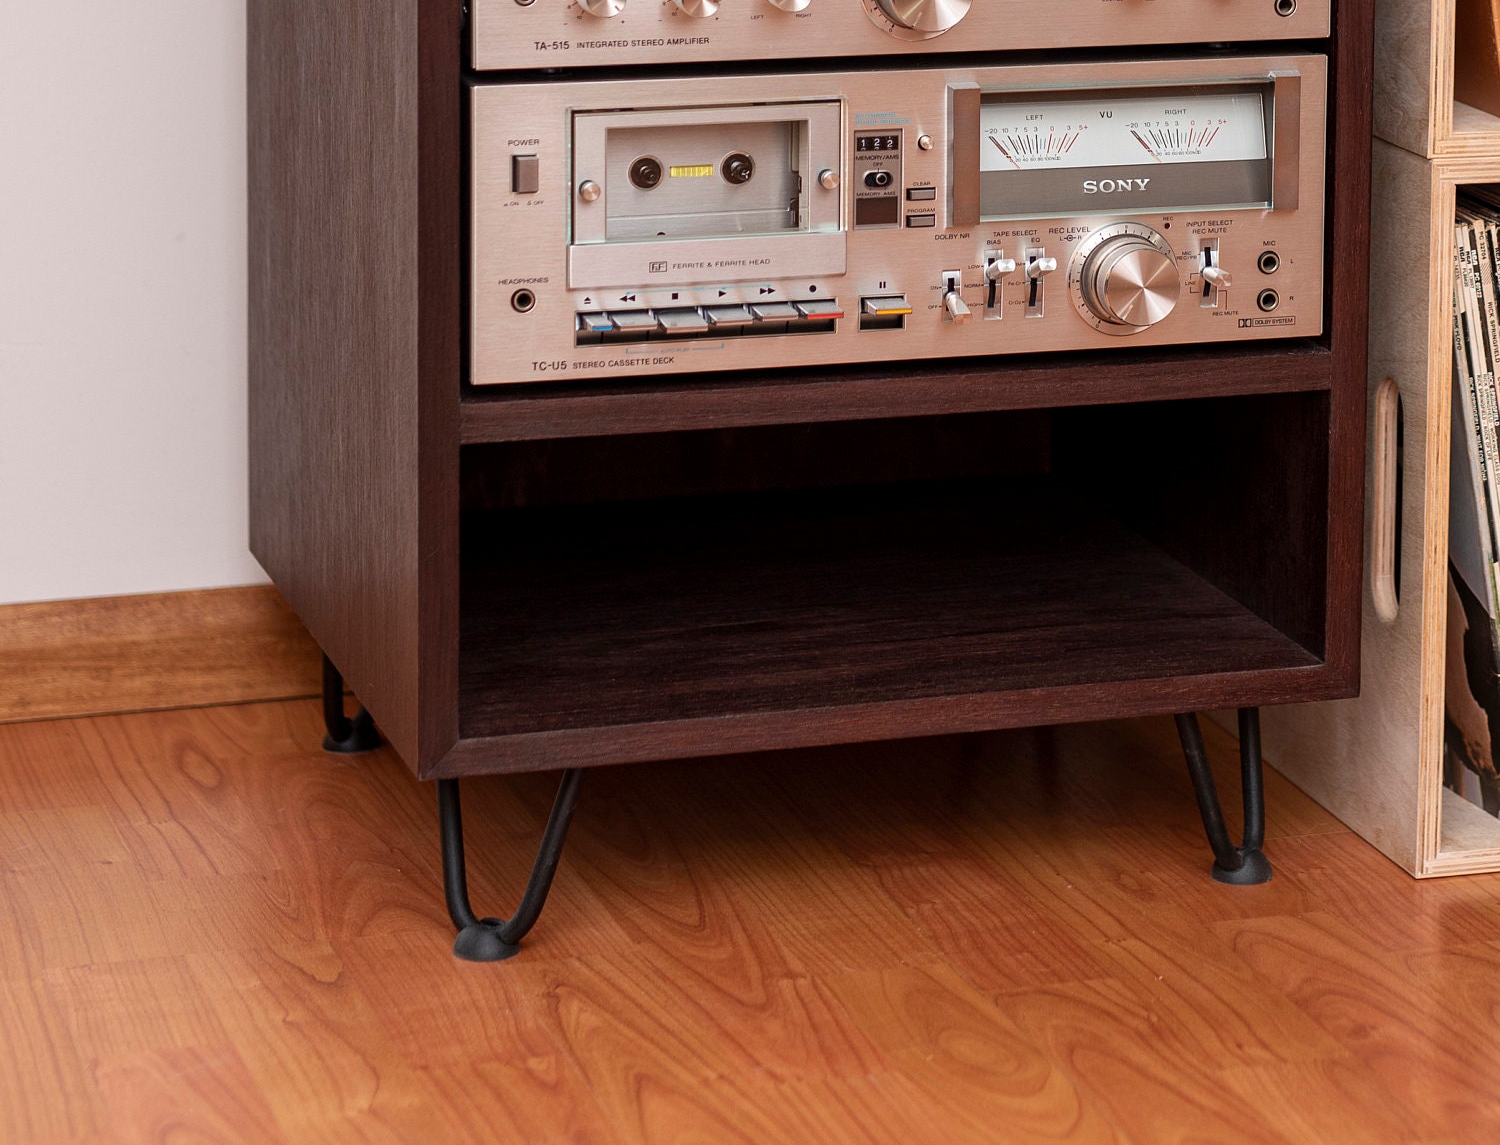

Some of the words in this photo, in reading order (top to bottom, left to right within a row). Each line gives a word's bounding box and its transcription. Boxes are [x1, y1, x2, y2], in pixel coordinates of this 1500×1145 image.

[535, 41, 569, 50] TA-515
[577, 40, 628, 49] INTEGRATED
[632, 39, 664, 47] STEREO
[667, 37, 709, 46] AMPLIFIER
[508, 139, 539, 147] POWER
[1084, 179, 1149, 193] SONY
[498, 277, 549, 285] HEADPHONES
[1490, 320, 1500, 362] SPRINGFIELD
[532, 361, 567, 371] TC-U5
[573, 361, 605, 370] STEREO
[608, 358, 649, 368] CASSETTE
[652, 356, 674, 365] DECK
